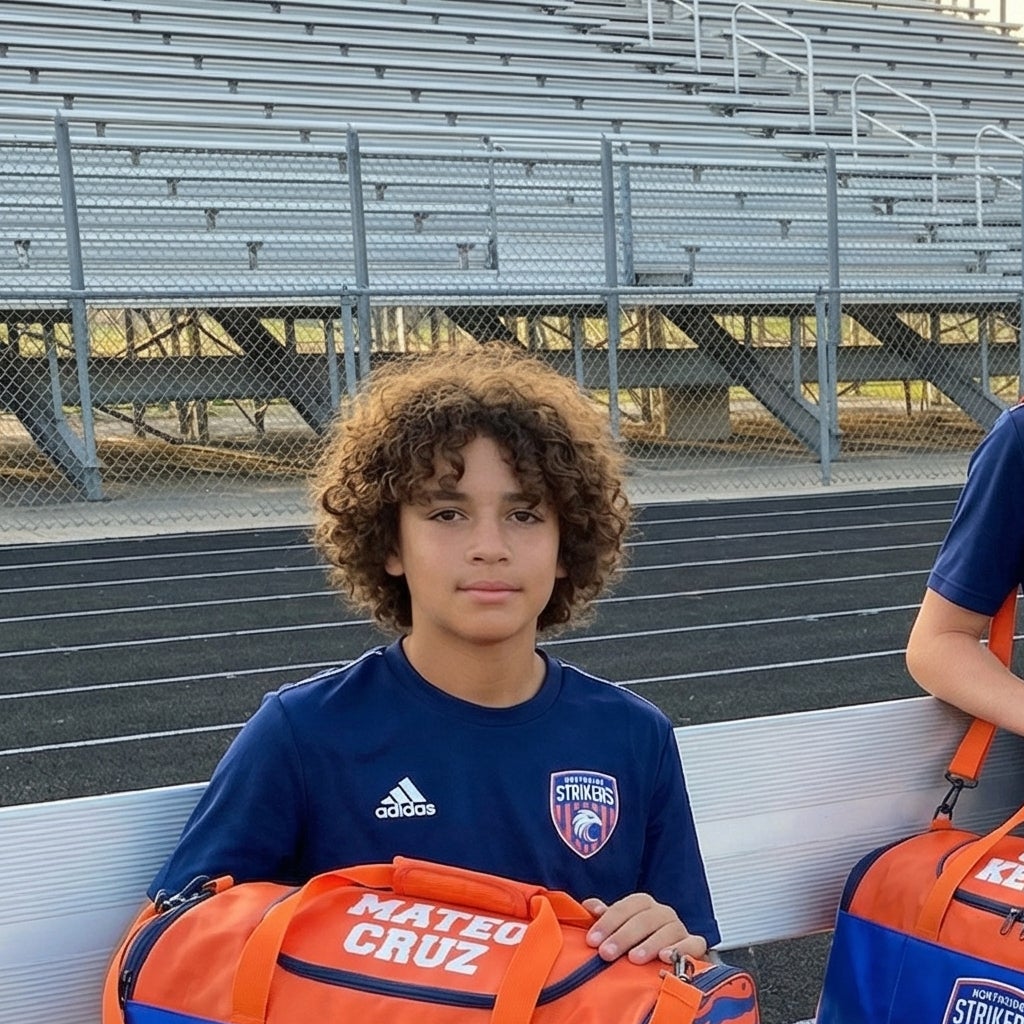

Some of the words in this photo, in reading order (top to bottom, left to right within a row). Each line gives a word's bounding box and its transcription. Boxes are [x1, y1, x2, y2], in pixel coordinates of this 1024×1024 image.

[375, 801, 437, 819] adidas
[347, 892, 529, 946] MATEO
[343, 922, 490, 975] CRUZ
